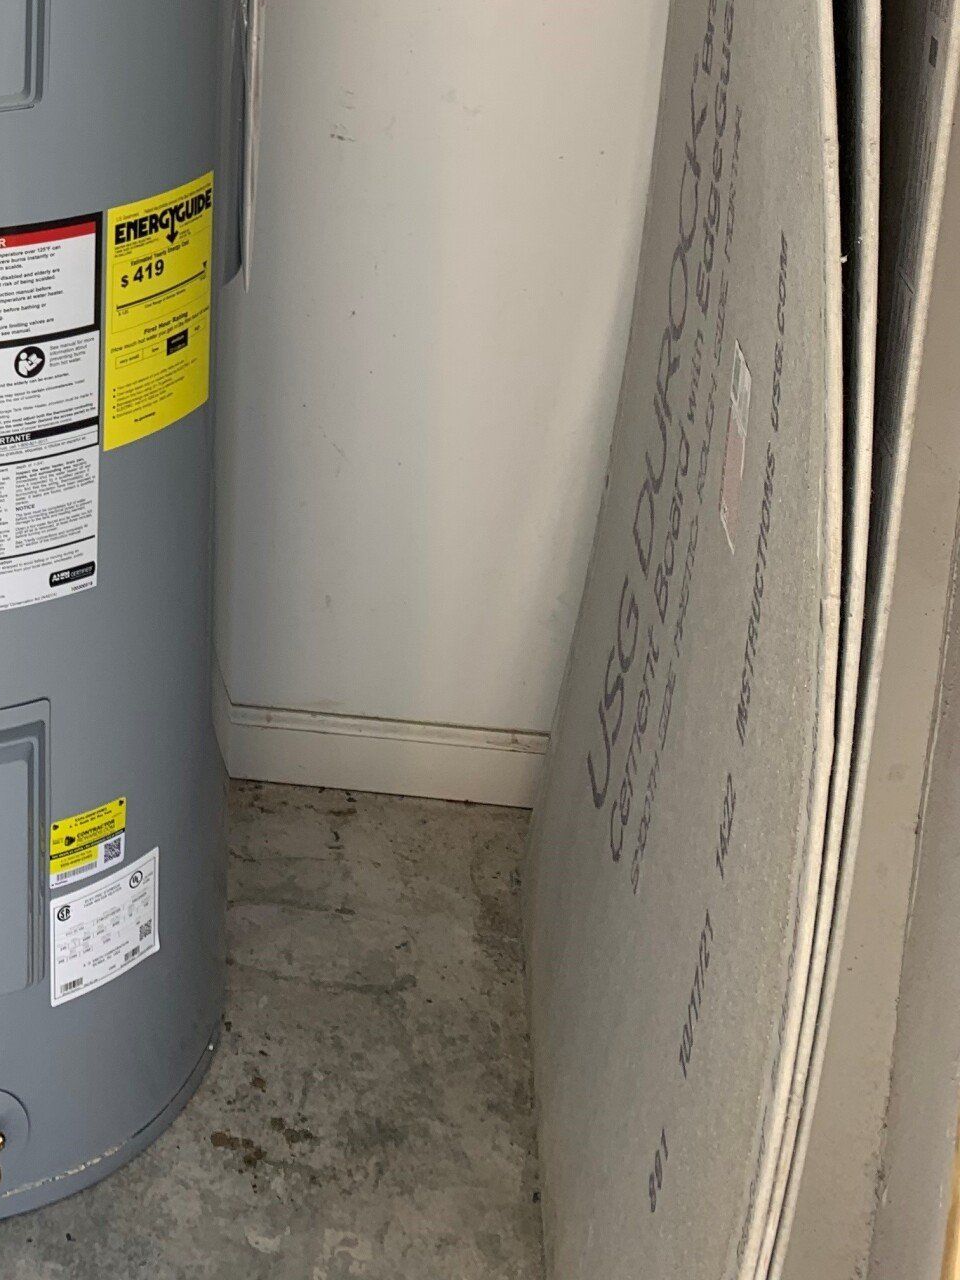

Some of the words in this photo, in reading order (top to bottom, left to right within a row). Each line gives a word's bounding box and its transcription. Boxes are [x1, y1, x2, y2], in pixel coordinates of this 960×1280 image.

[115, 188, 212, 246] ENERGYGUIDE
[133, 259, 165, 282] 419
[587, 574, 639, 810] USG
[632, 80, 708, 581] DUROCK
[610, 623, 660, 863] Cement
[653, 419, 690, 624] Board
[687, 328, 705, 424] with
[736, 441, 776, 747] INSTRUCTIONS
